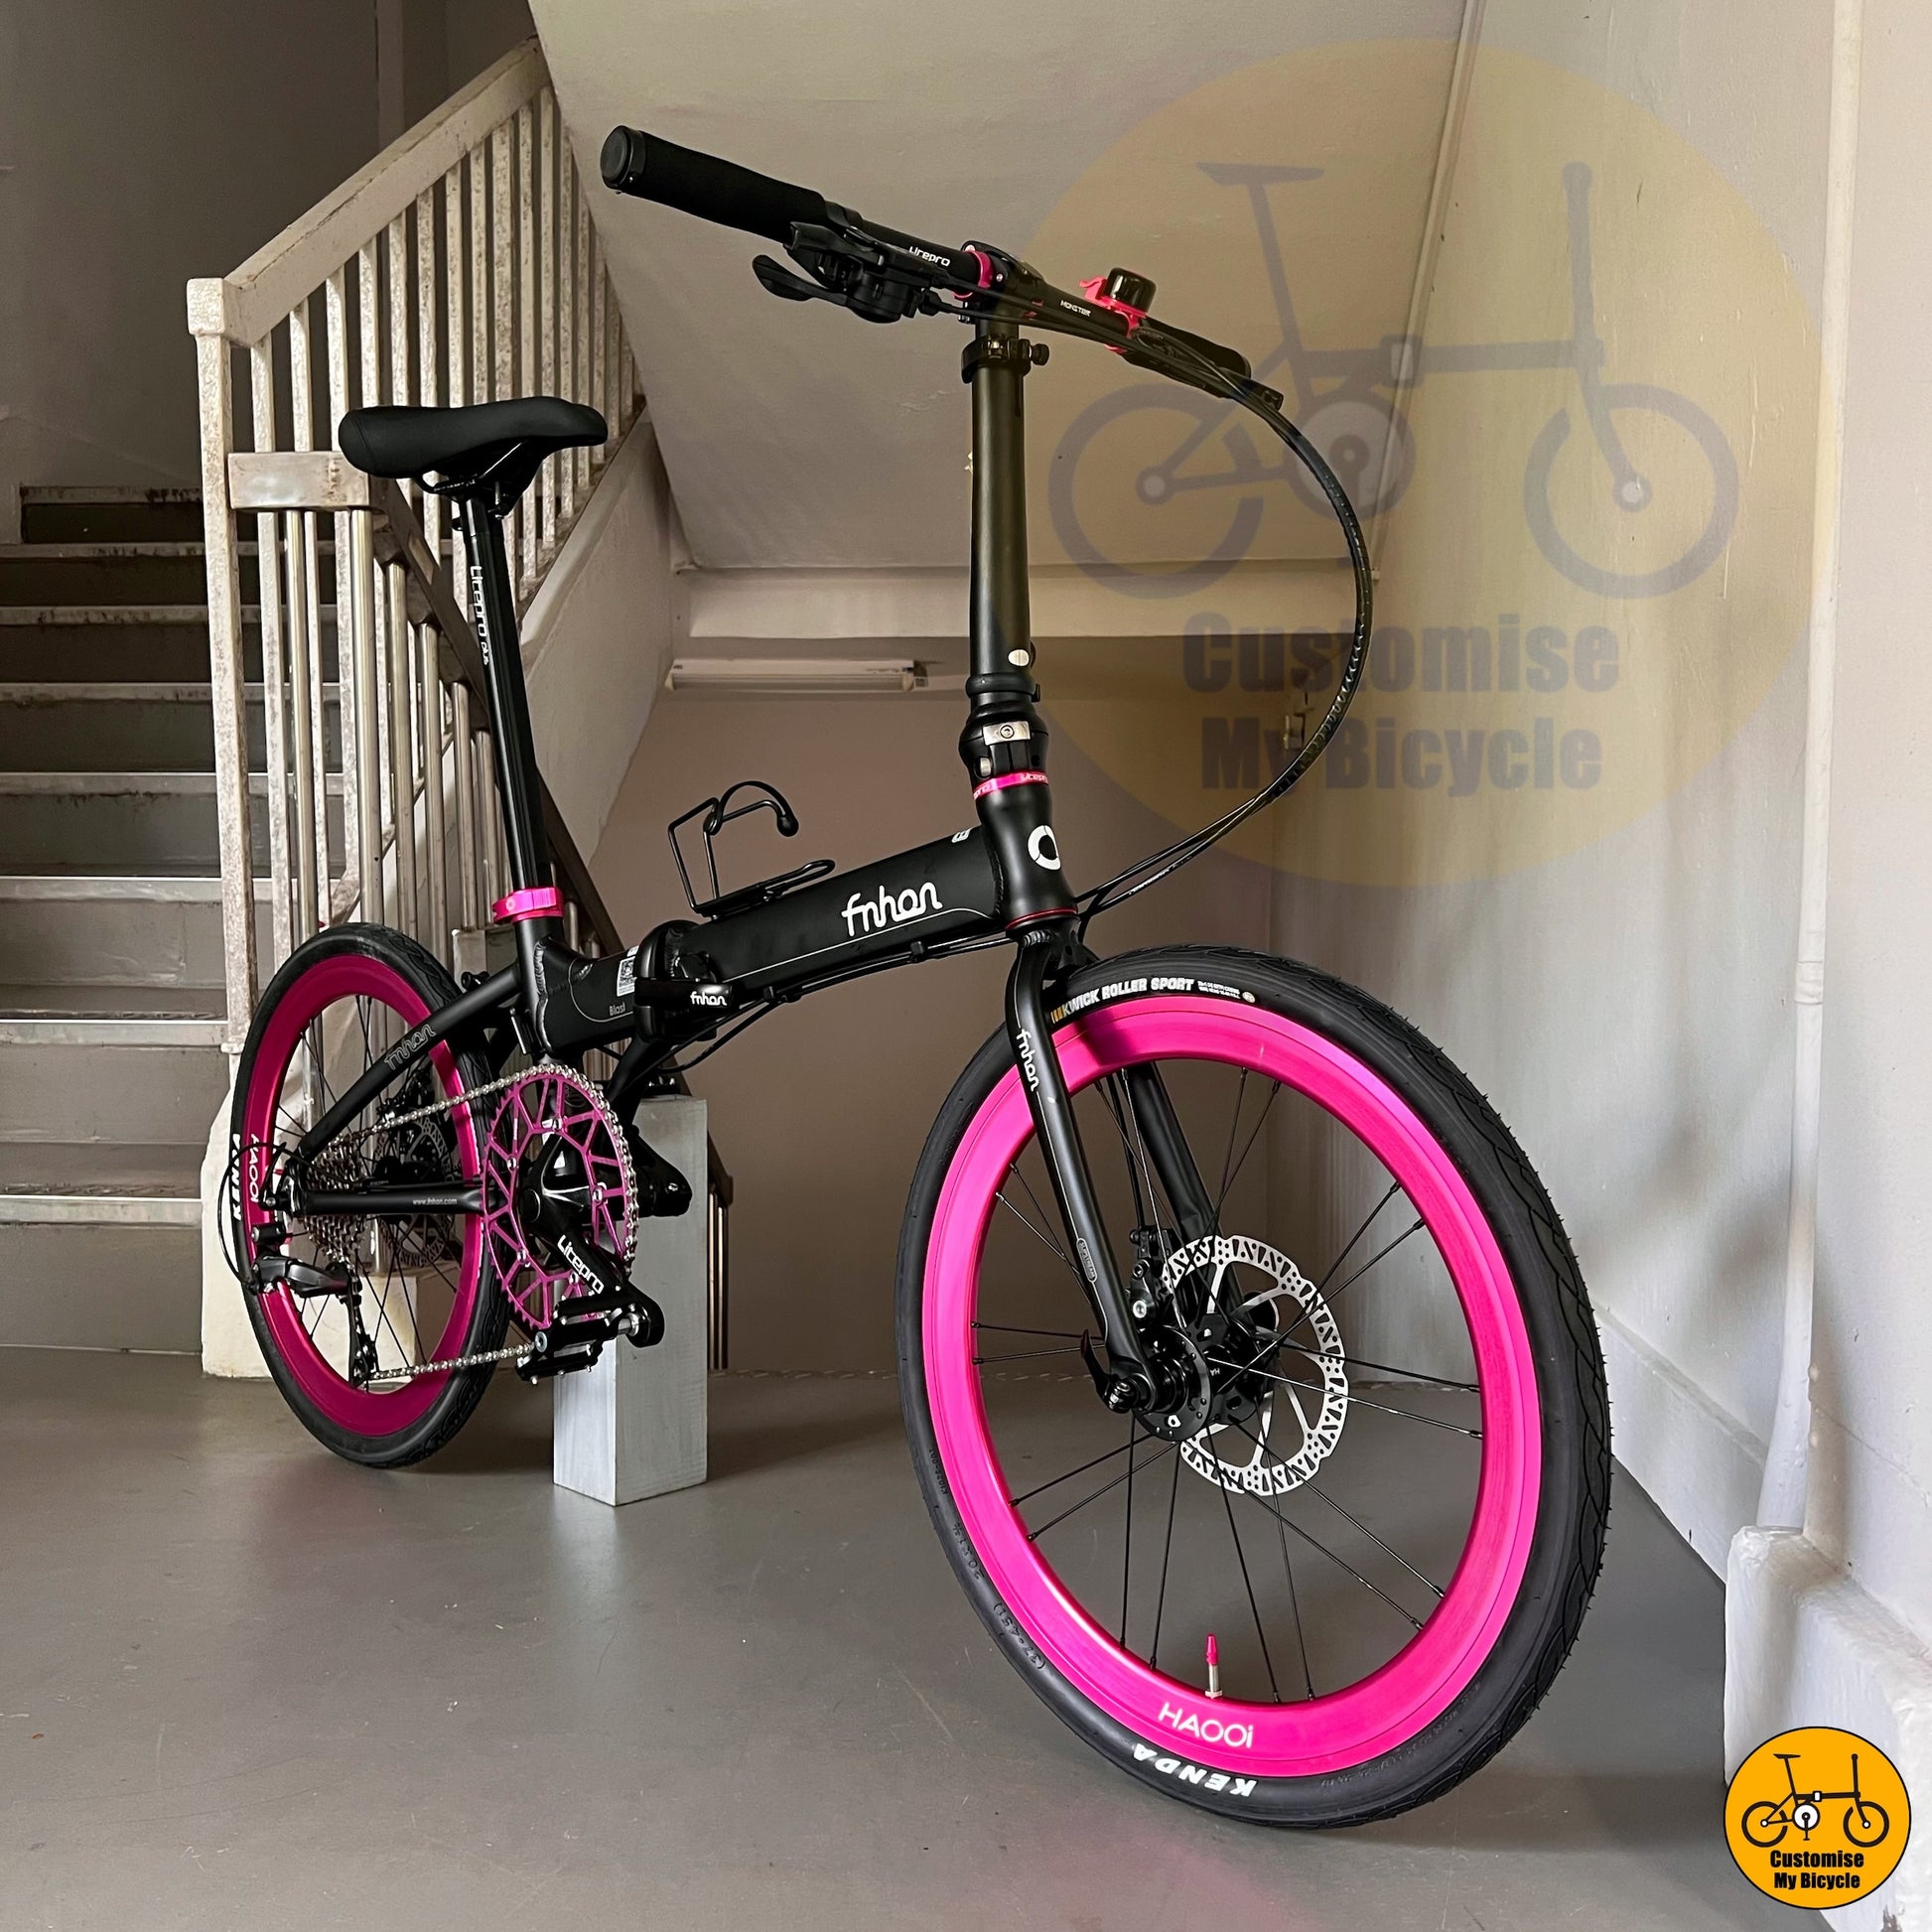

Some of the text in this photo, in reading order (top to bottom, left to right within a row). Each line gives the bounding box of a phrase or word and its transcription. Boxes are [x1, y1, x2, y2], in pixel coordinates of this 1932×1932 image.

[841, 882, 943, 936] fnhon
[690, 991, 727, 1006] fnhon
[1061, 988, 1100, 1019] KWICK
[1102, 978, 1148, 1000] ROLLER
[1151, 977, 1194, 991] SPORT
[1016, 1029, 1039, 1092] fnhon
[1133, 1742, 1258, 1798] KENDA
